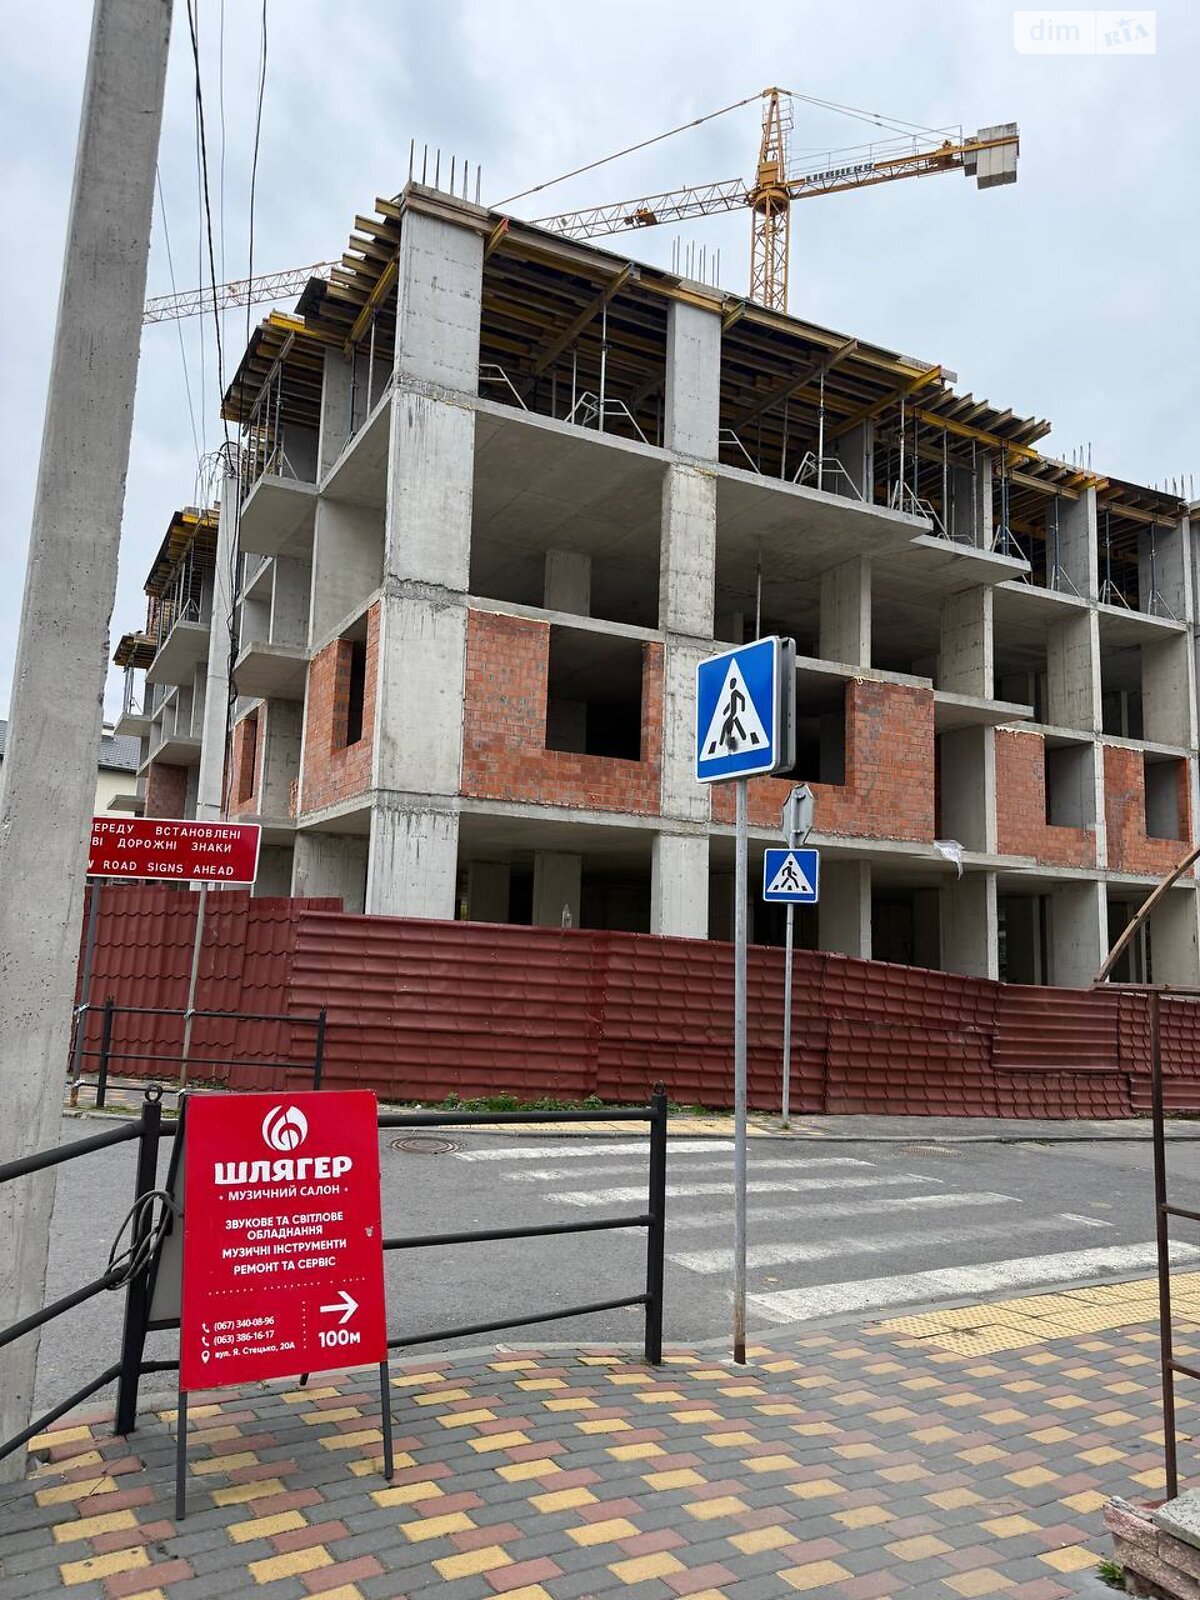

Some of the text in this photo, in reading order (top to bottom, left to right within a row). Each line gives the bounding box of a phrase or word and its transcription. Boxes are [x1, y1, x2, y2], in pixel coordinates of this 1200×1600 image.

[155, 826, 241, 839] ВСТАНОВЛЕНІ
[91, 836, 232, 853] ВІ ДОРОЖНІ ЗНАКИ
[103, 860, 137, 871] ROAD
[147, 863, 184, 873] SIGNS
[193, 864, 235, 876] AHEAD
[214, 1155, 353, 1185] ШЛЯГЕР
[228, 1184, 340, 1201] МУЗИЧНИЙ САЛОН
[225, 1211, 343, 1230] ЗВУКОВЕ ТА СВІТЛОВЕ
[247, 1225, 323, 1241] ОБЛАДНАННЯ
[222, 1238, 347, 1259] МУЗИЧНІ ІНСТРУМЕНТИ
[233, 1256, 336, 1276] РЕМОНТ ТА СЕРВІС
[214, 1320, 235, 1332] (067)
[213, 1330, 275, 1346] (063) 386-16-17
